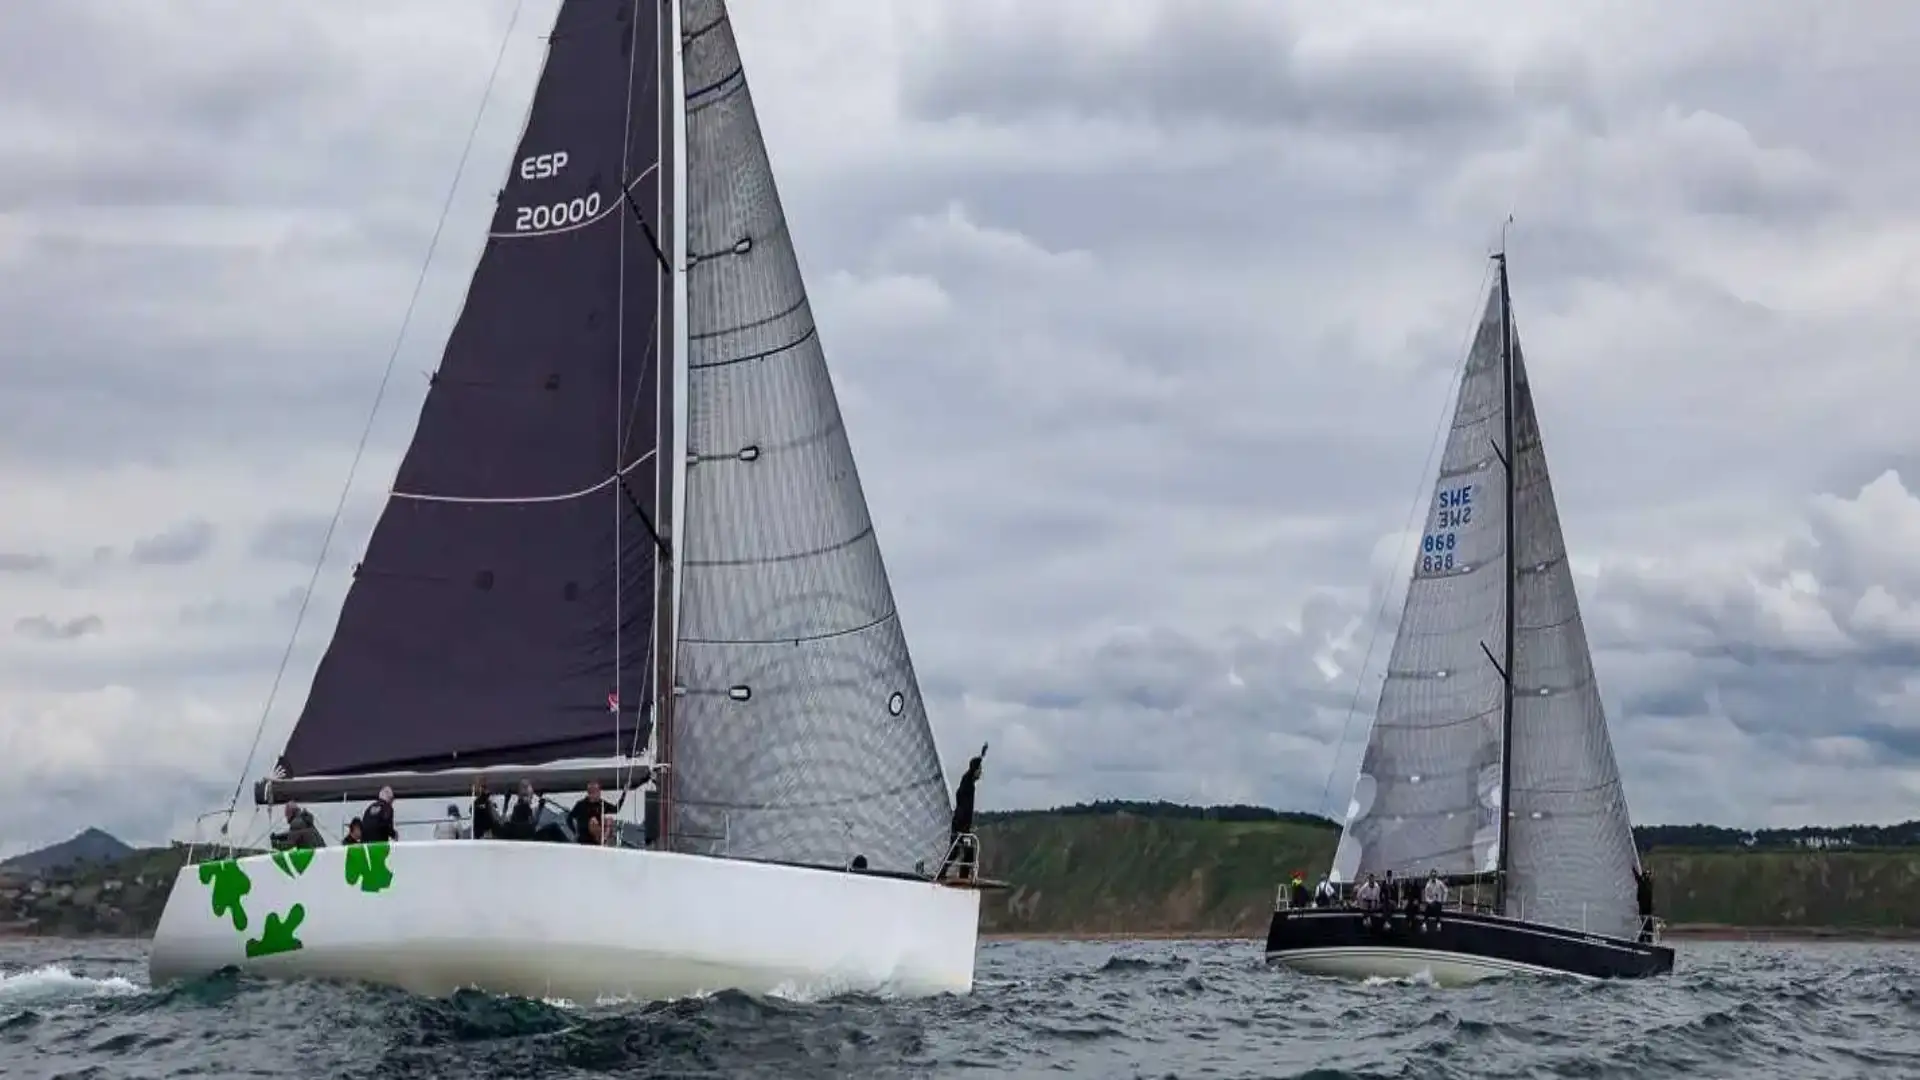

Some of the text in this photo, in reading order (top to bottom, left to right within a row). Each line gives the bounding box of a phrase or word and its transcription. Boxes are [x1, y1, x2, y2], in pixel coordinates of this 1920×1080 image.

[520, 151, 569, 180] ESP
[515, 191, 601, 231] 20000
[1439, 485, 1472, 508] SWE
